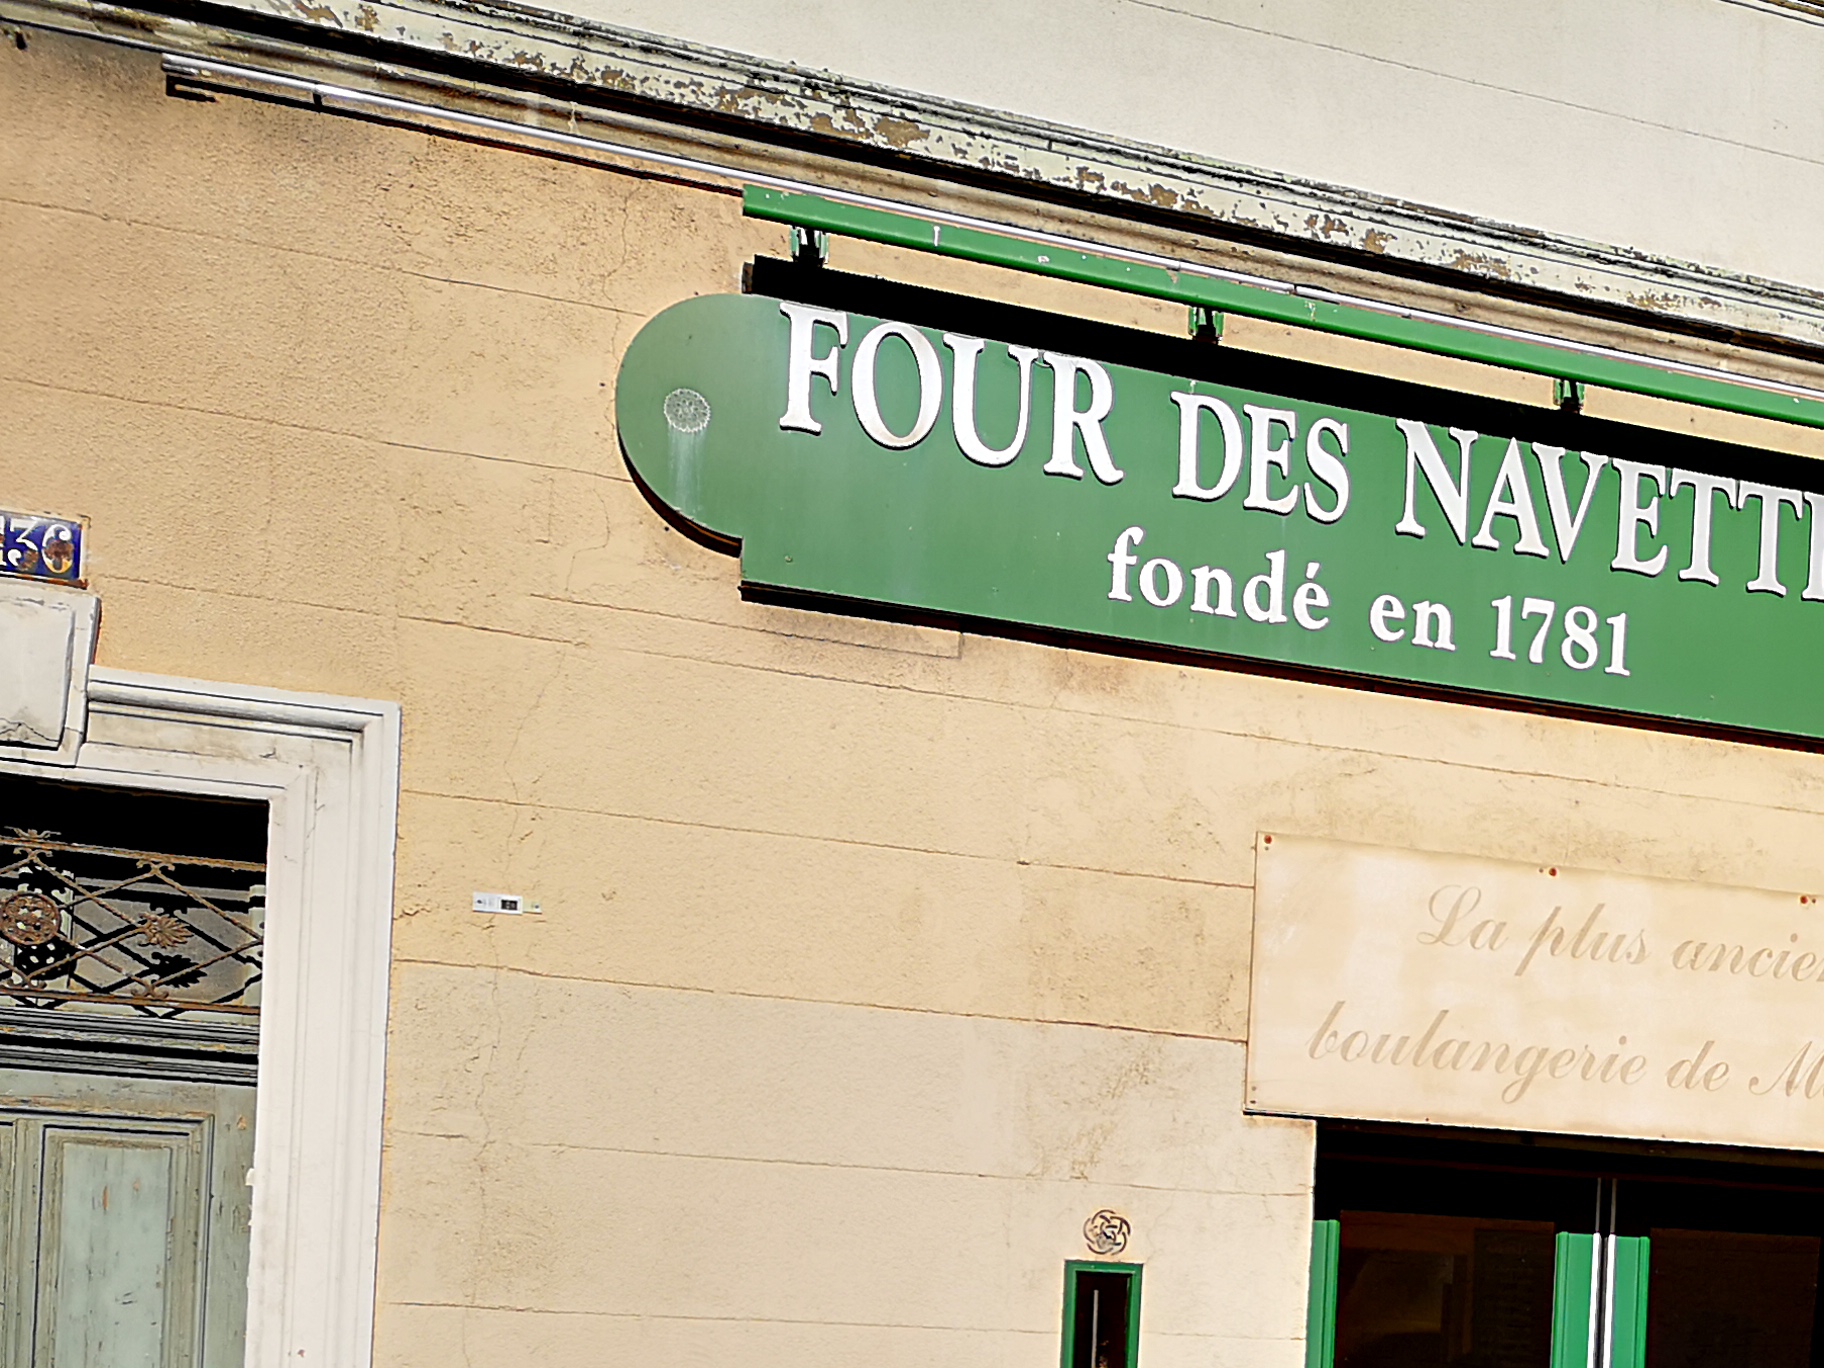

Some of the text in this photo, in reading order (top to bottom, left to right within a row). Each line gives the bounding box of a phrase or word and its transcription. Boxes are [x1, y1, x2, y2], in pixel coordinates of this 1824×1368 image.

[779, 300, 1124, 484] FOUR
[1170, 391, 1351, 524] DES
[1107, 526, 1632, 678] fondé en 1781
[1417, 885, 1508, 951] La
[1513, 903, 1650, 977] plus
[1306, 1000, 1647, 1104] boulangerie
[1666, 1040, 1730, 1091] de
